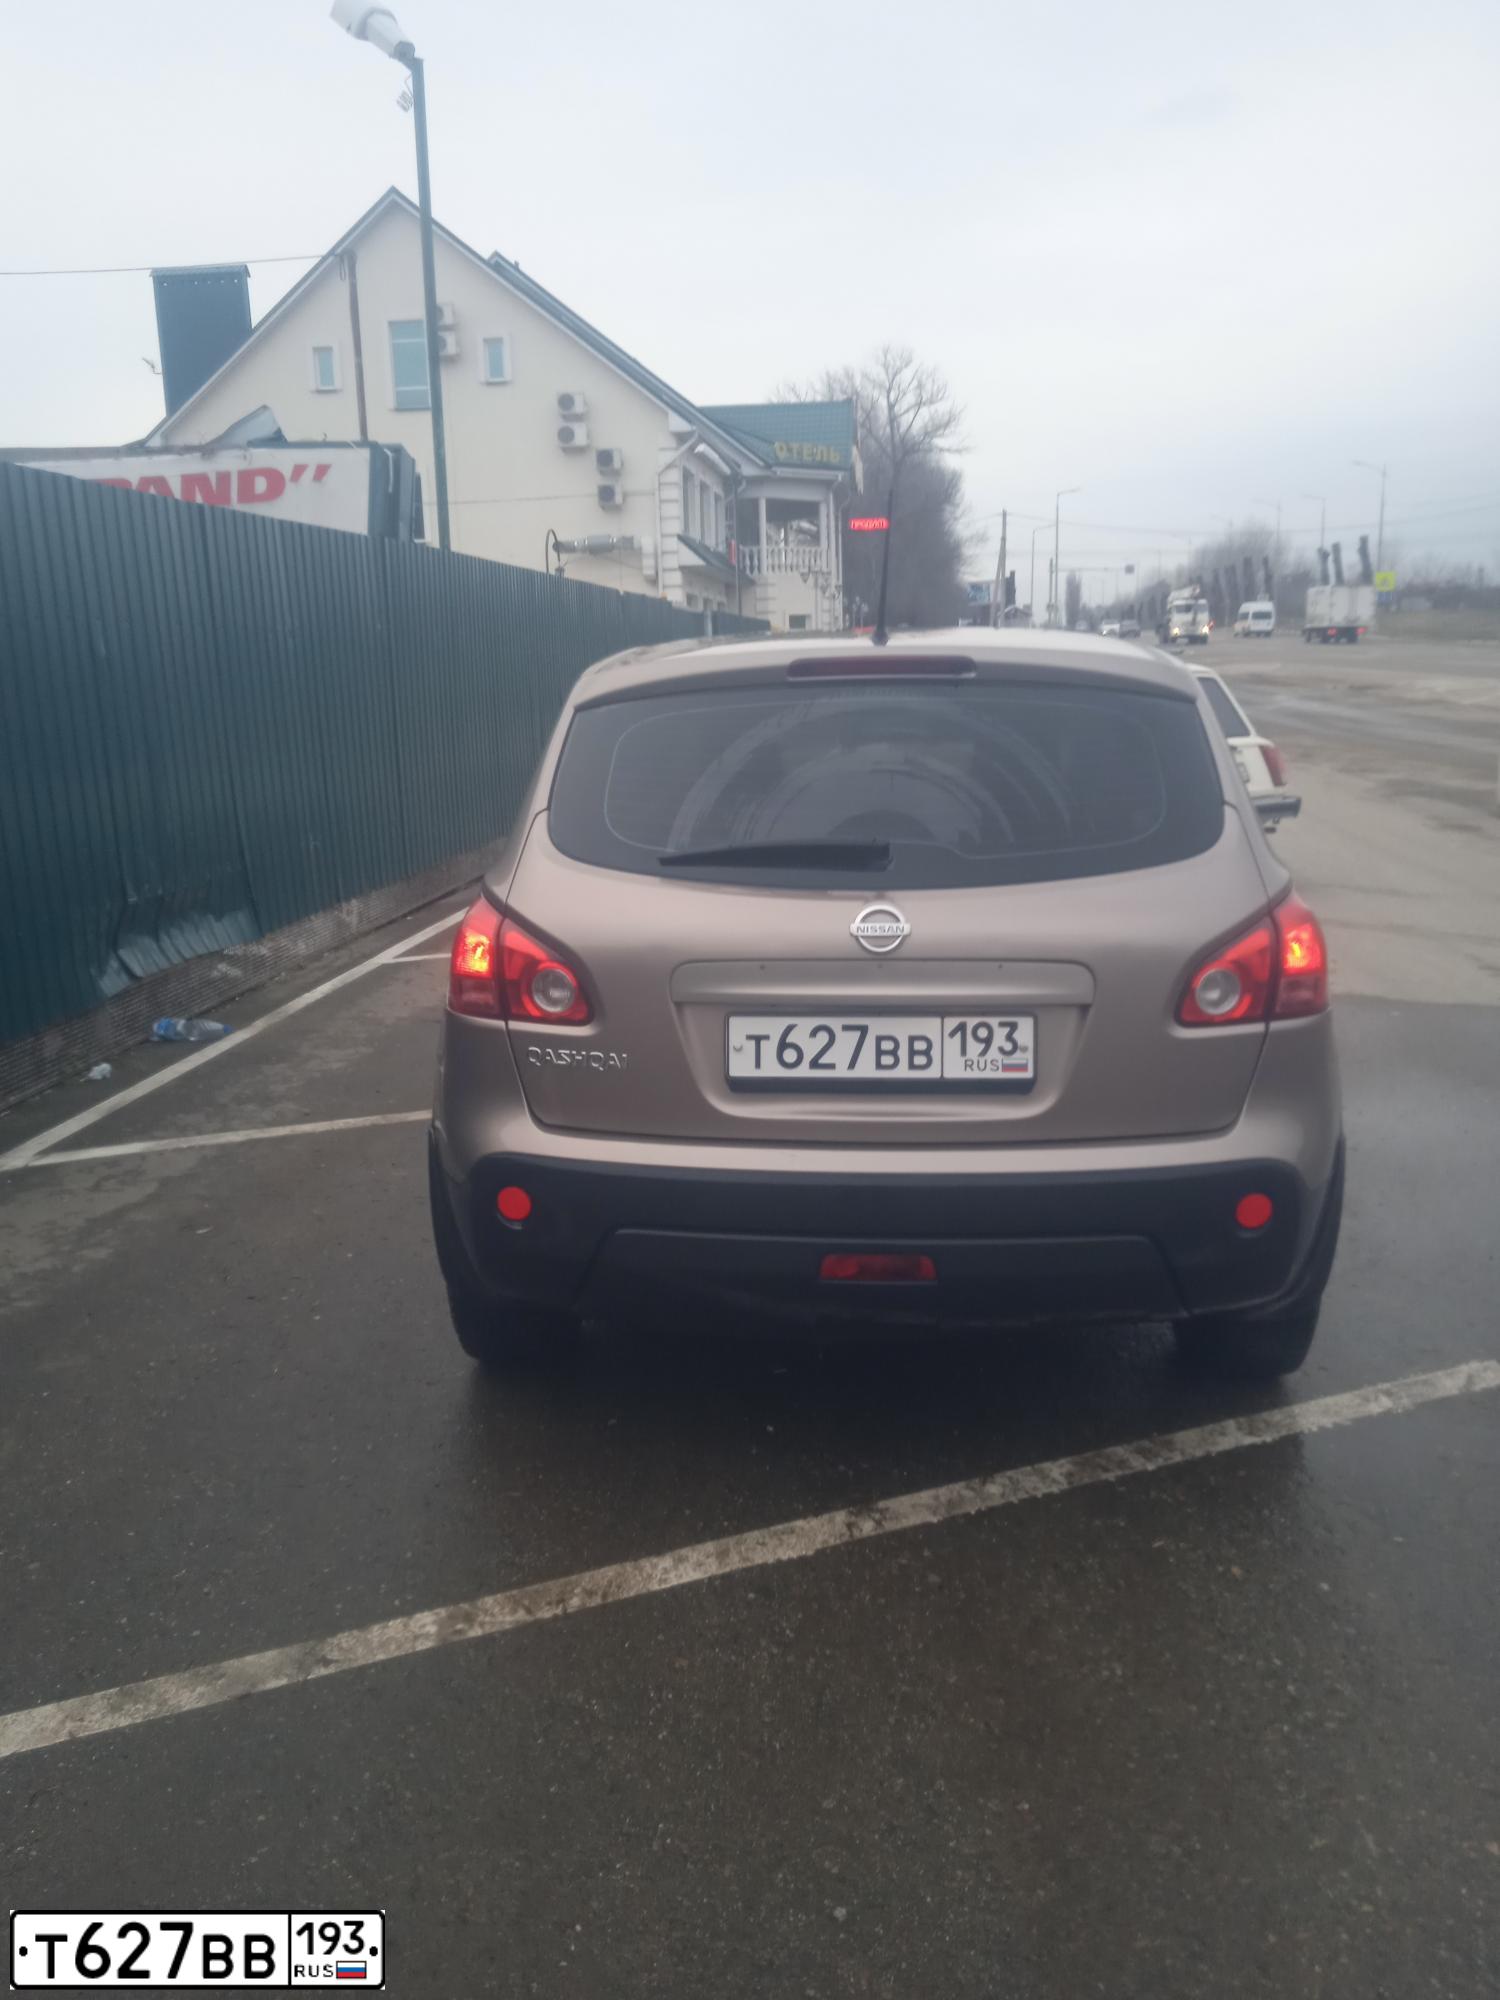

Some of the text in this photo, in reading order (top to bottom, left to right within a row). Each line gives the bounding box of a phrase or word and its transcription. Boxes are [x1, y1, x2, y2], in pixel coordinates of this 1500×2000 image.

[857, 925, 905, 934] NISSAN
[948, 1021, 1019, 1057] 193
[528, 1046, 628, 1071] QASHQAI
[964, 1058, 1000, 1072] RUS
